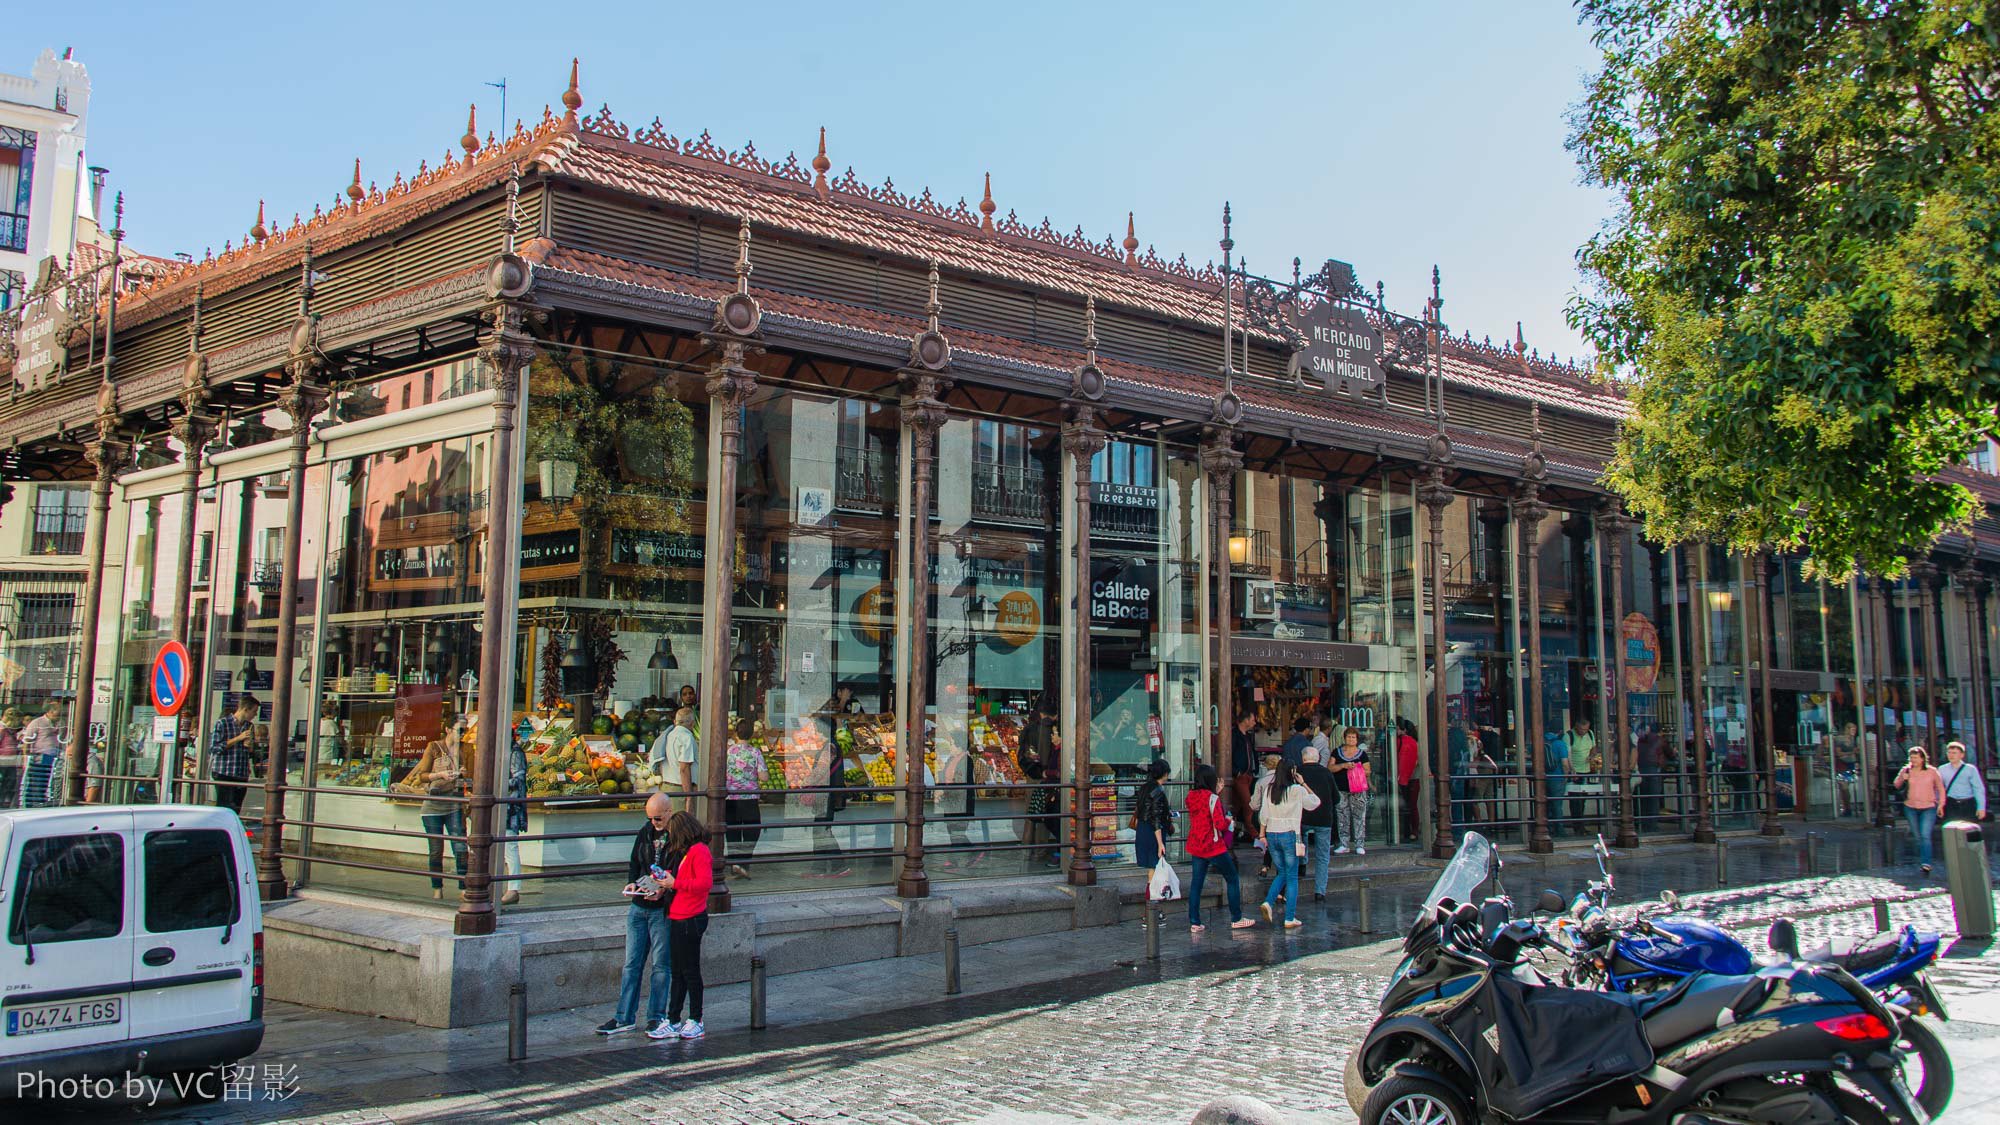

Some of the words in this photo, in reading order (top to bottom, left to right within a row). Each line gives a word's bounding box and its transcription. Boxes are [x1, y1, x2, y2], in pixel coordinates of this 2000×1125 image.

[22, 318, 55, 344] MERCADO
[1314, 325, 1371, 351] MERCADO
[32, 340, 41, 352] DE
[1336, 348, 1351, 359] DE
[18, 358, 30, 375] SAN
[31, 349, 53, 369] MIGUEL
[1313, 356, 1335, 374] SAN
[1337, 360, 1375, 381] MIGUEL
[520, 545, 541, 559] rutas
[650, 542, 703, 559] Verduras
[1092, 581, 1150, 600] Cállate
[1108, 600, 1149, 620] Boca
[6, 984, 33, 992] OPEL
[22, 1007, 73, 1028] 0474
[79, 1002, 115, 1021] FGS
